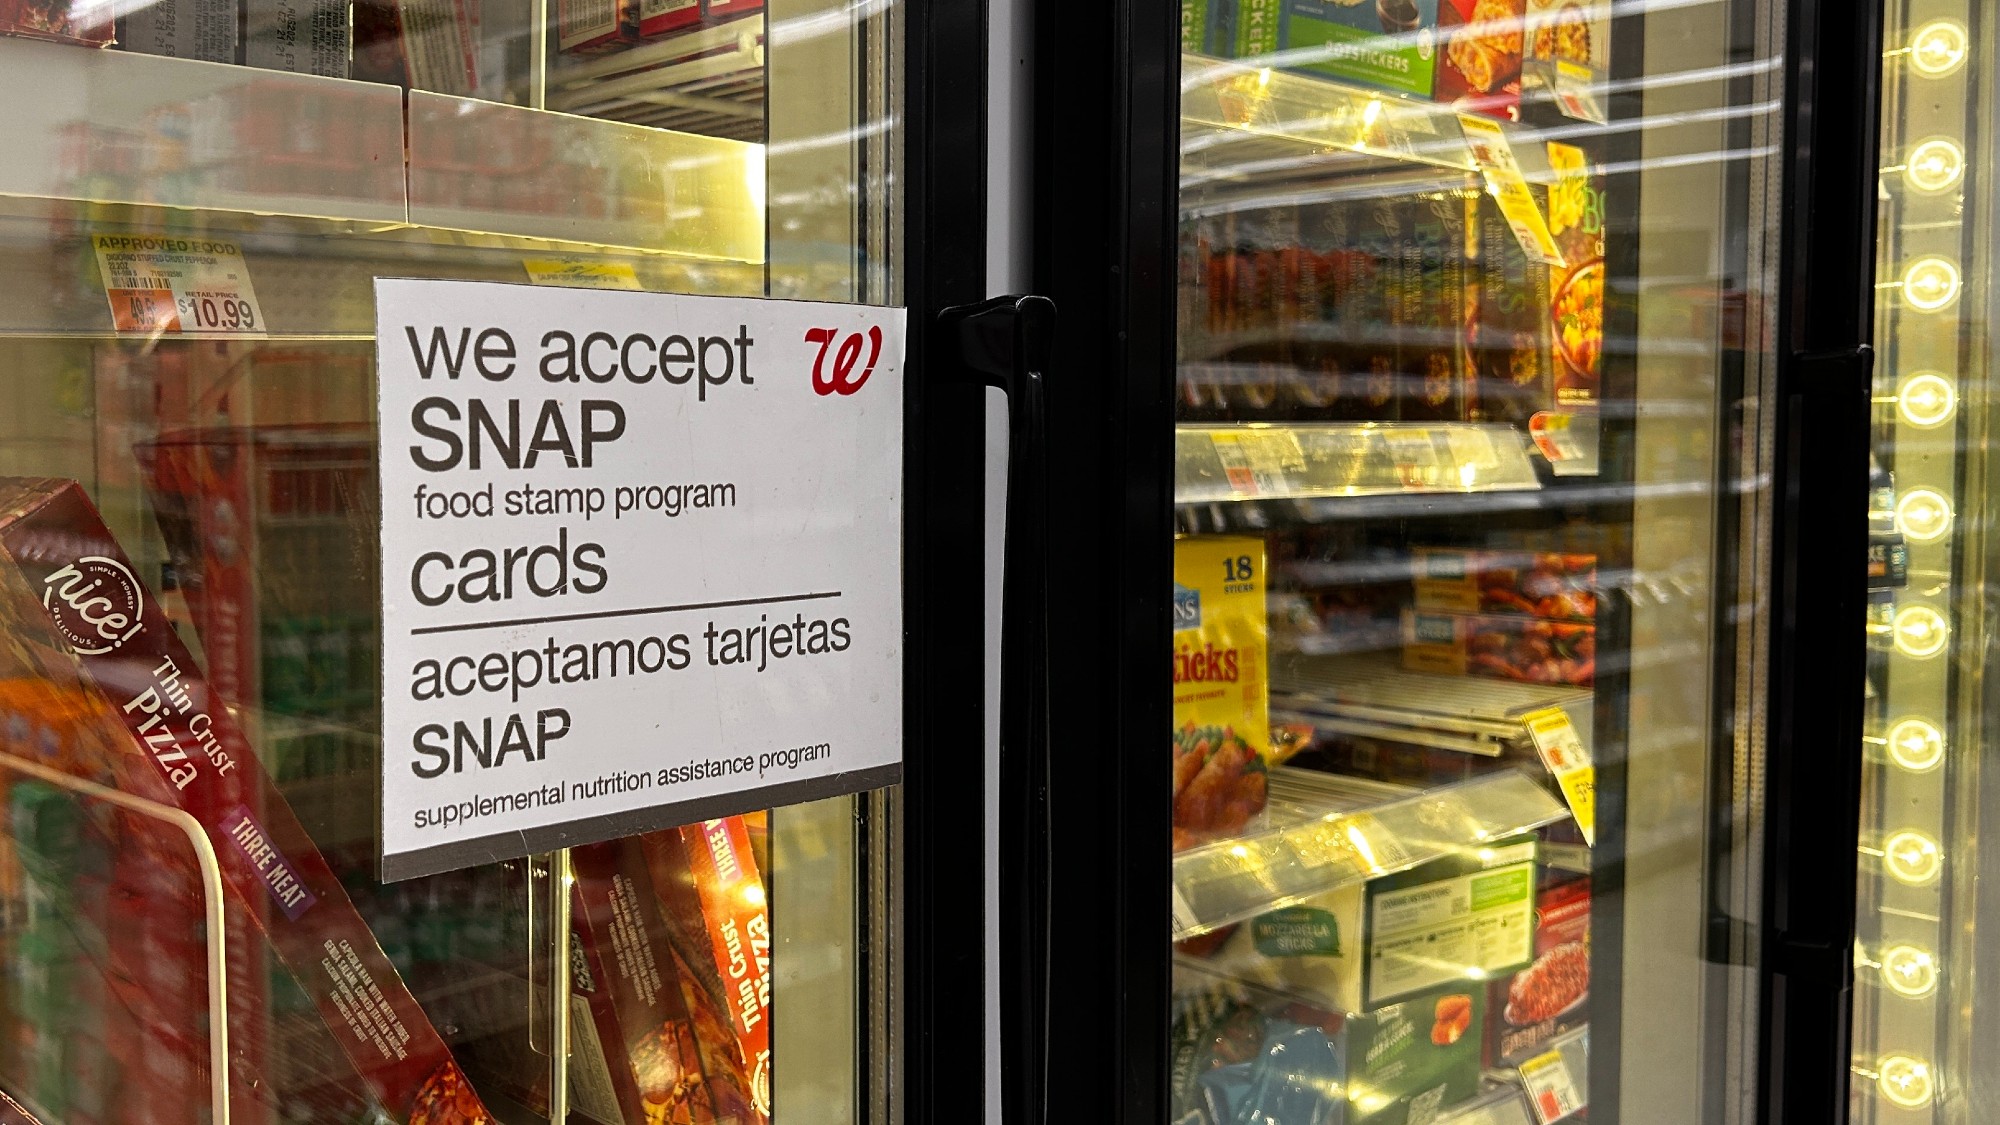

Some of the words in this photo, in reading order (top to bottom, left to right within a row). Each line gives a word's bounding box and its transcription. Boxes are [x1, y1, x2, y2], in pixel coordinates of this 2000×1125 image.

[99, 236, 188, 251] APPROVED
[191, 241, 236, 256] FOOD
[178, 298, 255, 328] $10.99
[185, 291, 213, 299] RETAIL
[215, 291, 239, 299] PRICE
[404, 325, 517, 382] we
[539, 324, 754, 402] accept
[409, 396, 626, 473] SNAP
[414, 483, 494, 519] food
[505, 483, 605, 521] stamp
[615, 482, 737, 519] program
[89, 565, 117, 578] SIMPLE
[121, 579, 134, 611] HONEST
[411, 527, 608, 607] cards
[1223, 555, 1253, 584] 18
[1223, 583, 1254, 595] STICKS
[44, 563, 143, 648] nice!
[53, 607, 92, 646] DELICIOUS
[411, 634, 691, 703] aceptamos
[703, 613, 851, 672] tarjetas
[123, 685, 198, 791] Pizza
[153, 654, 193, 715] Thin
[188, 713, 236, 777] Crust
[411, 708, 572, 779] SNAP
[414, 780, 565, 829] supplemental
[572, 771, 652, 800] nutrition
[657, 755, 754, 787] assistance
[759, 742, 831, 774] program
[231, 815, 272, 871] THREE
[266, 865, 306, 909] MEAT
[709, 826, 738, 880] THREE
[720, 918, 747, 979] Crust
[738, 977, 761, 1033] Thin
